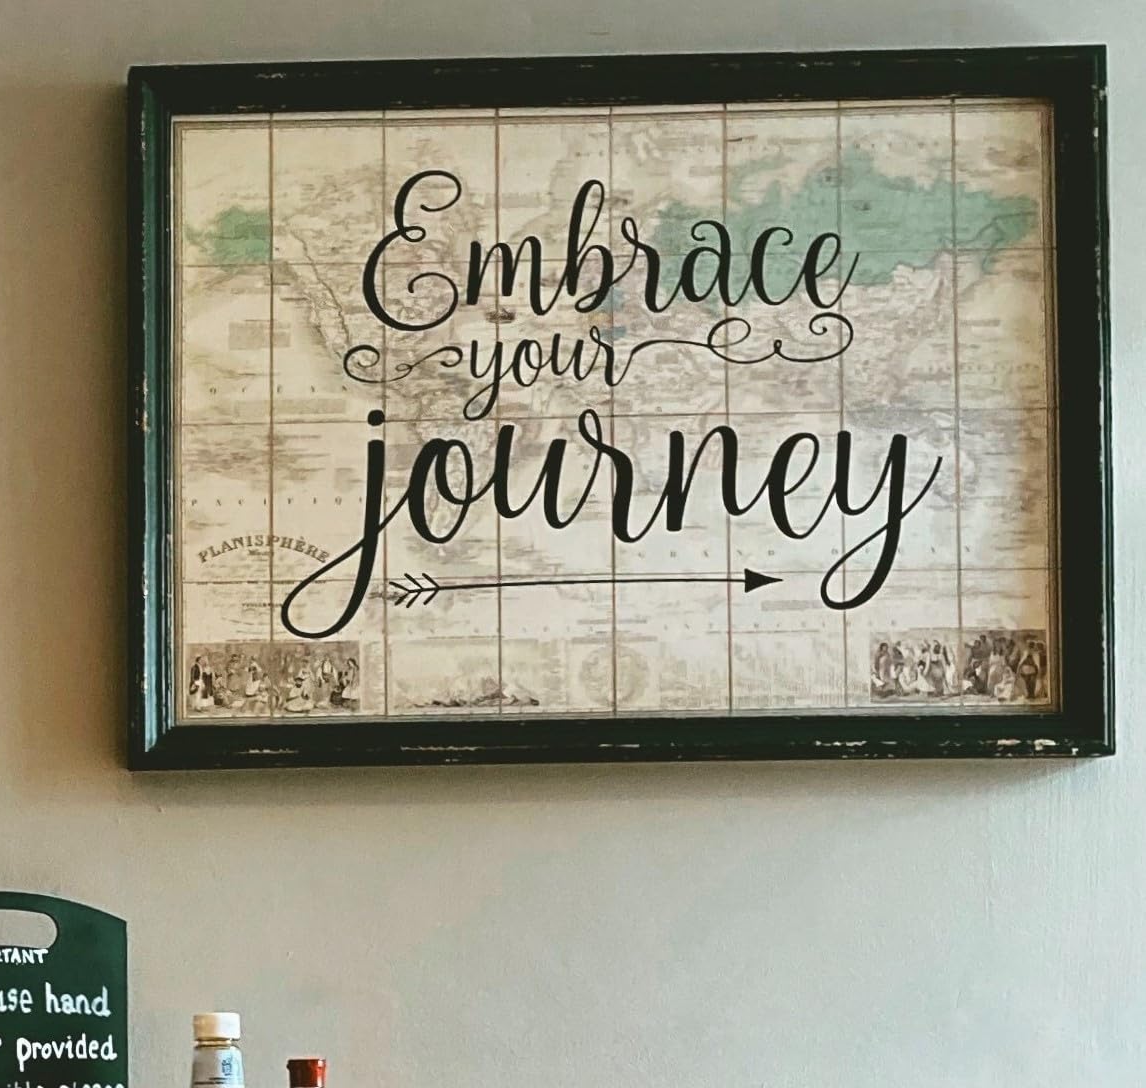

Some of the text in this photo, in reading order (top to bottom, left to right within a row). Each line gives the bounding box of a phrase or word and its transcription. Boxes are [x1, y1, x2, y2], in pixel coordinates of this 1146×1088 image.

[362, 170, 859, 331] Embrace
[281, 409, 943, 638] journey
[198, 535, 330, 563] PLANISPHÈRE
[45, 982, 112, 1018] hand
[16, 1033, 118, 1072] provided
